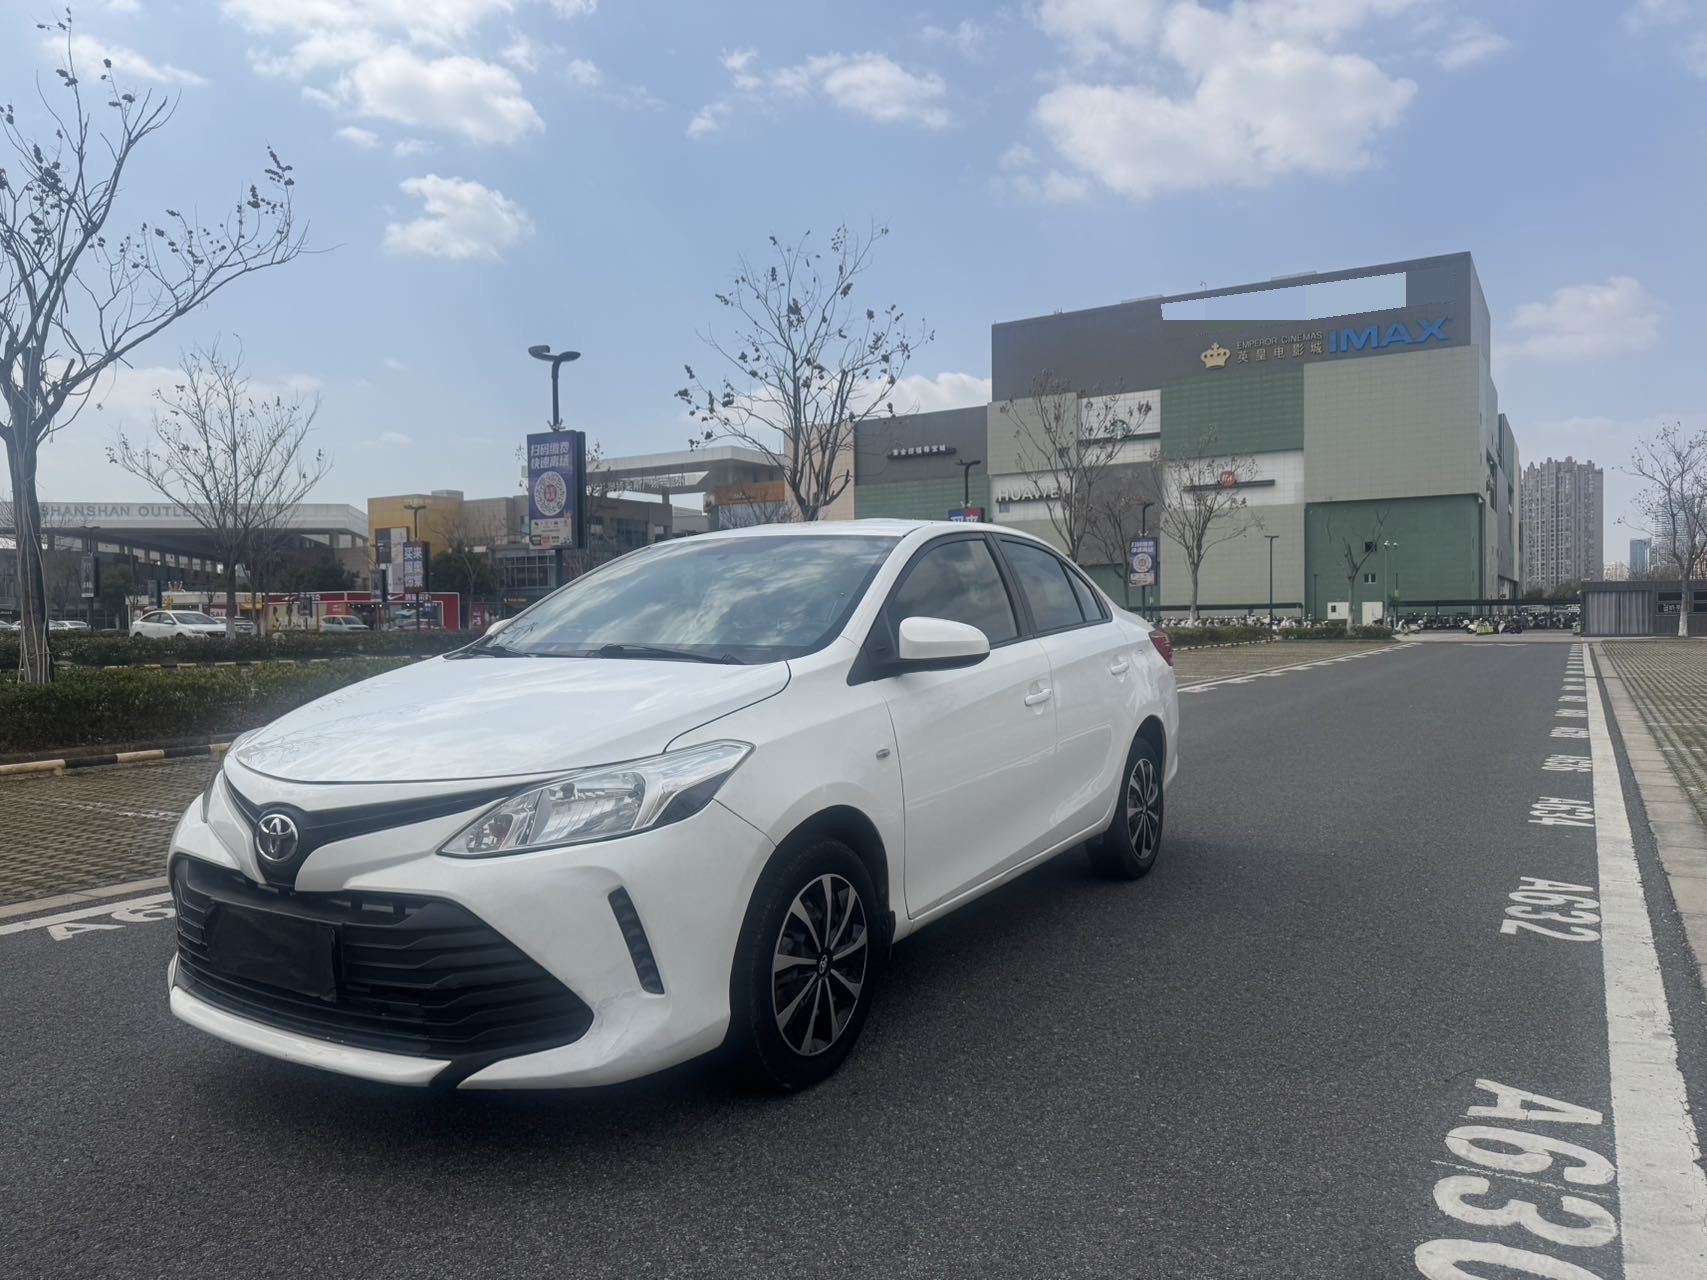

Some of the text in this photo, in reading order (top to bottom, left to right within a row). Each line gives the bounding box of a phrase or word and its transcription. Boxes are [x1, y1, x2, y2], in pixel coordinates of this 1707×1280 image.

[1236, 330, 1323, 350] EMPEROR CINEMAS
[1328, 316, 1449, 352] IMAX
[1237, 341, 1324, 363] 英皇电影城
[40, 505, 130, 518] SHANSHAN
[1528, 796, 1596, 828] A634
[1500, 876, 1601, 942] A632
